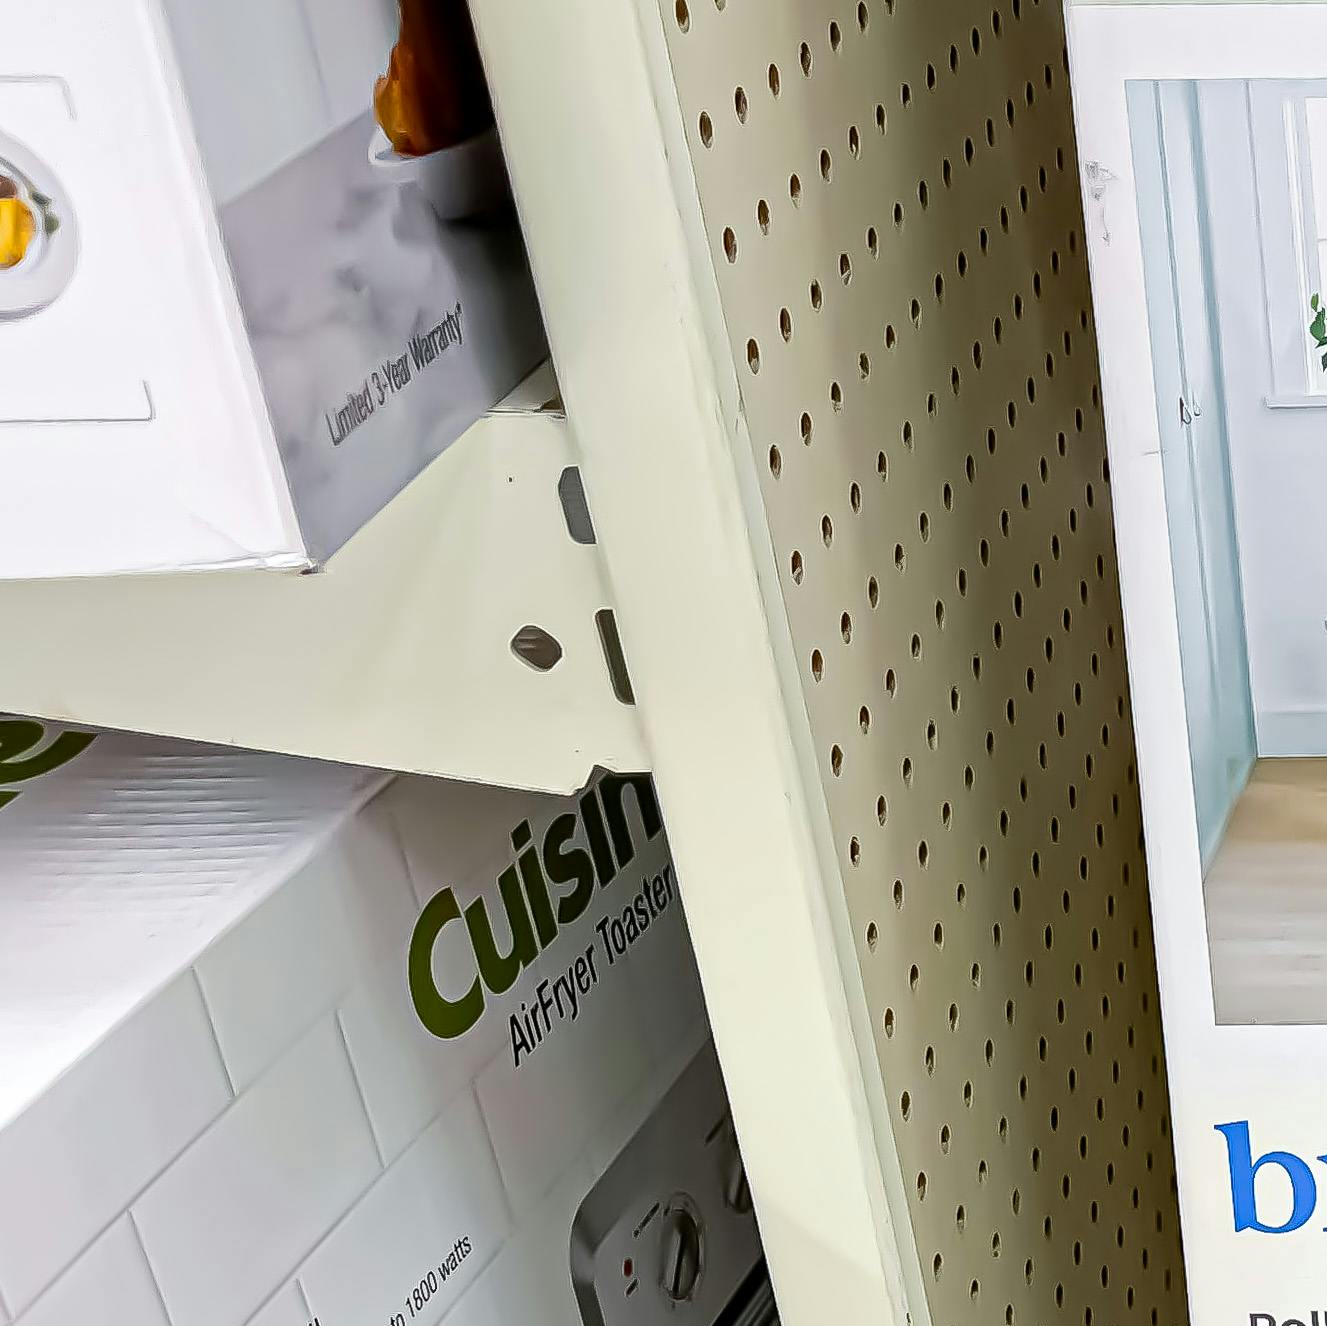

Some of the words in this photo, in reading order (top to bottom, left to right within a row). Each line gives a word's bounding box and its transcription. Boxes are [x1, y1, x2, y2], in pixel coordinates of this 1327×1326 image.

[325, 379, 374, 446] Limited
[371, 353, 412, 407] 3-Year
[506, 944, 597, 1070] AirFryer
[594, 863, 675, 967] Toaster
[406, 1271, 437, 1317] 1800
[438, 1237, 471, 1281] watts
